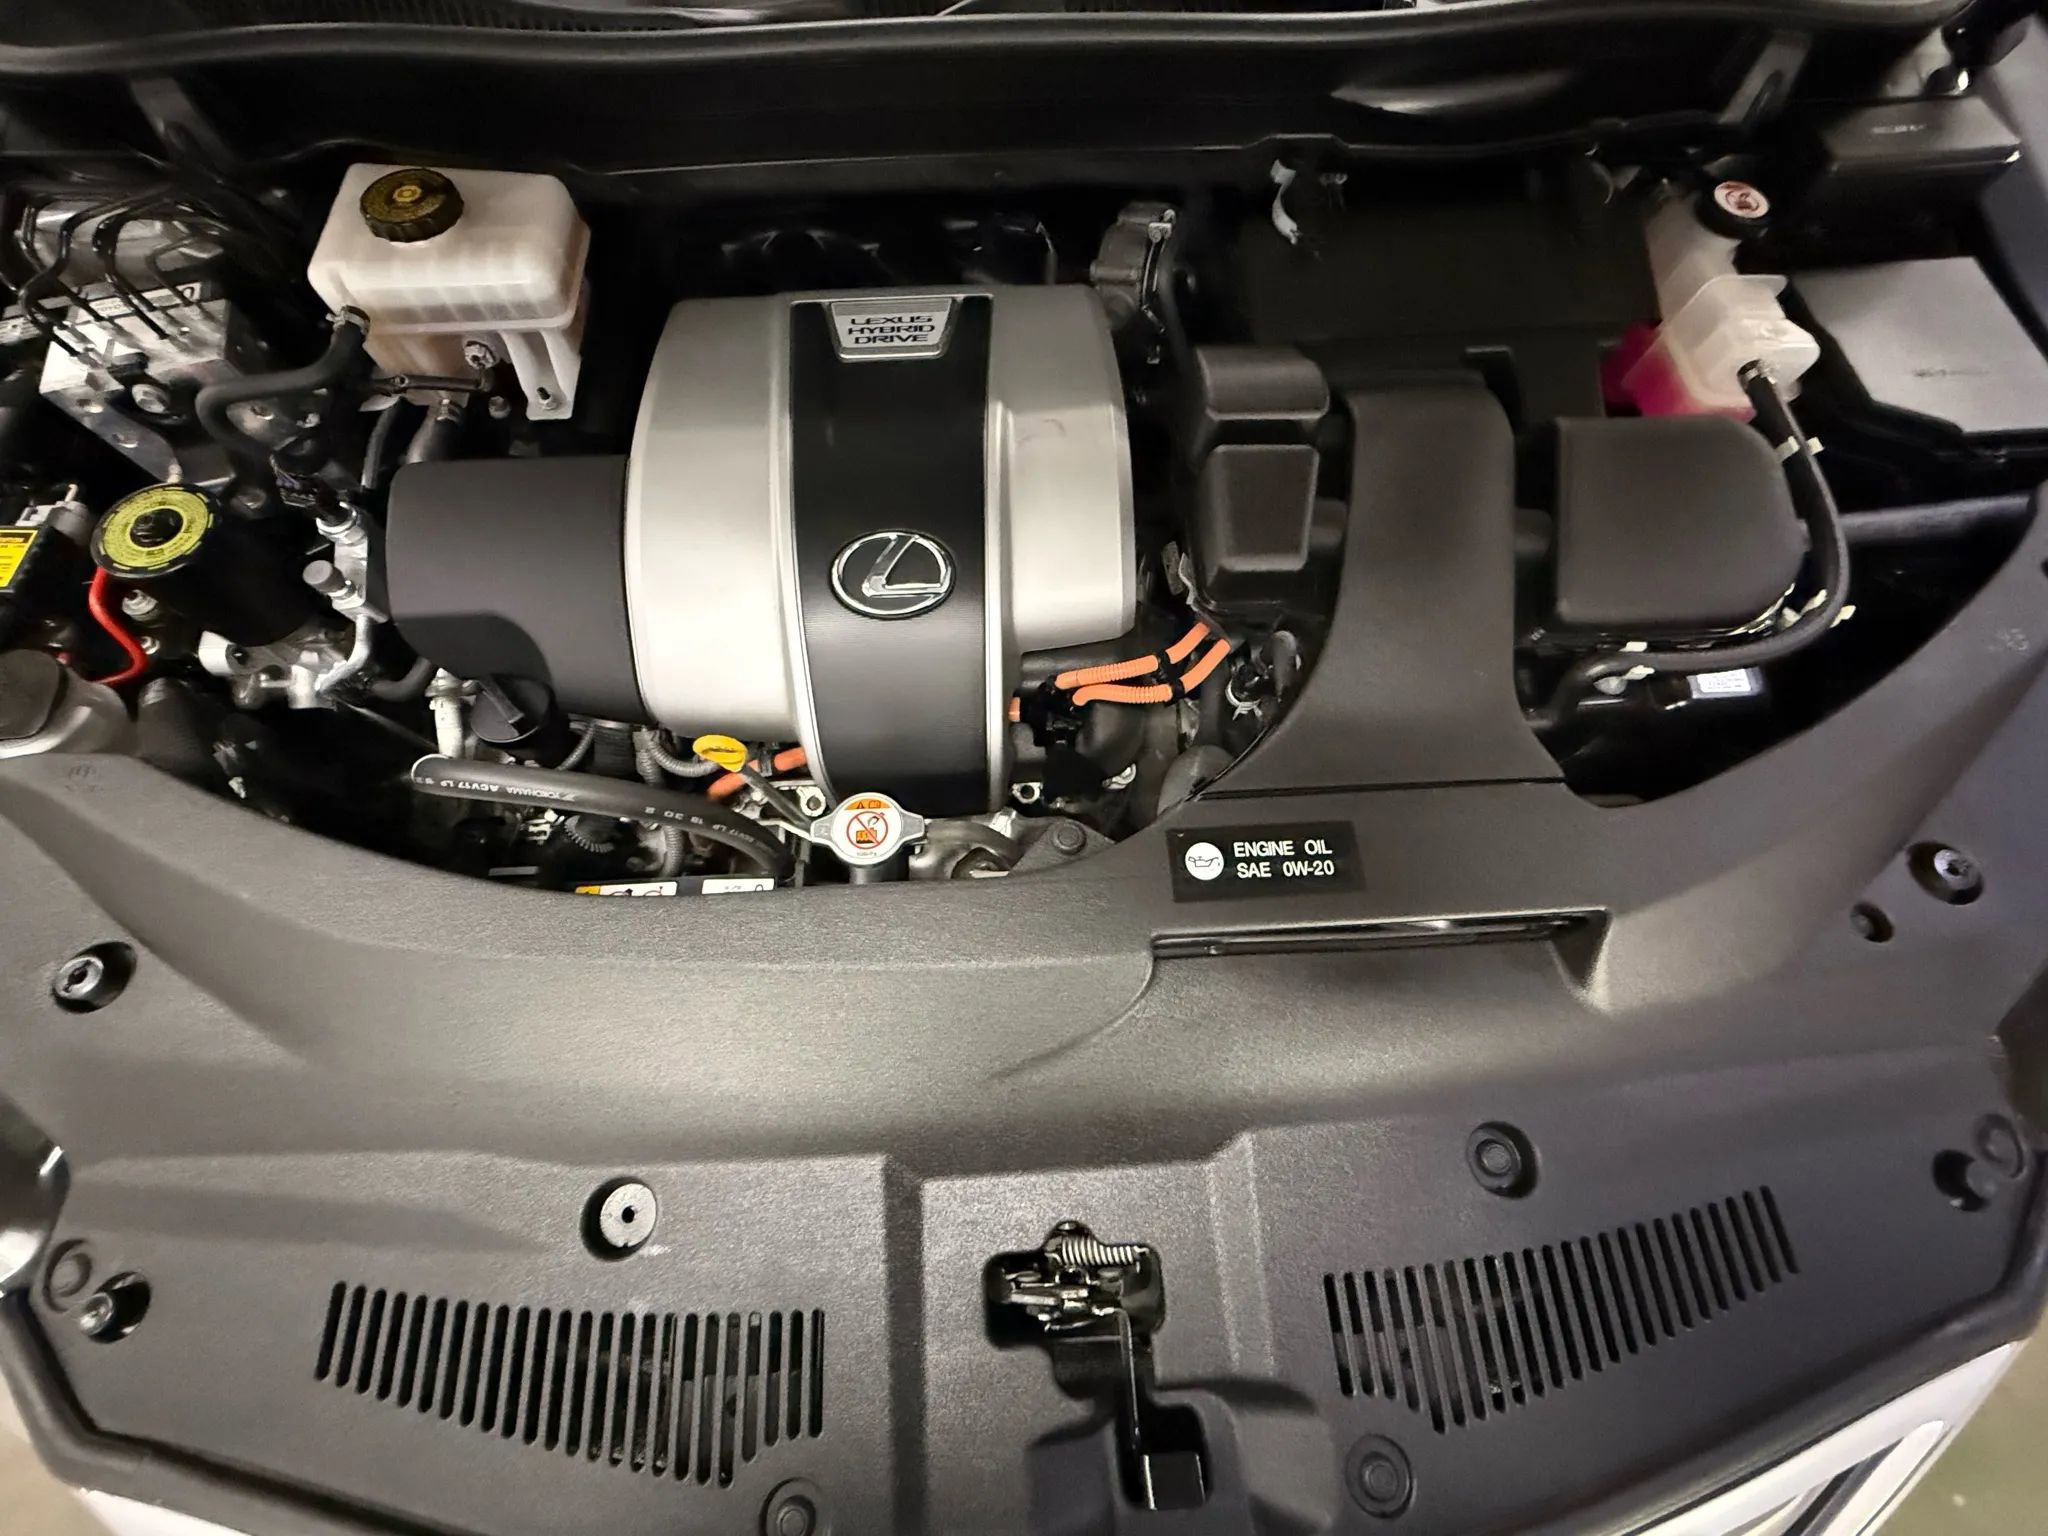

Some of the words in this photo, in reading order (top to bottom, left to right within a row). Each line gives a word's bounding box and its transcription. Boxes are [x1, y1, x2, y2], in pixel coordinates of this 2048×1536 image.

[851, 315, 932, 325] LEXUS
[848, 325, 934, 334] HYBRID
[855, 334, 928, 344] DRIVE
[506, 786, 561, 800] YOKOHAMA
[1233, 840, 1294, 857] ENGINE
[1303, 839, 1333, 856] OIL
[1236, 861, 1272, 879] SAE
[1283, 860, 1335, 877] 0W-20
